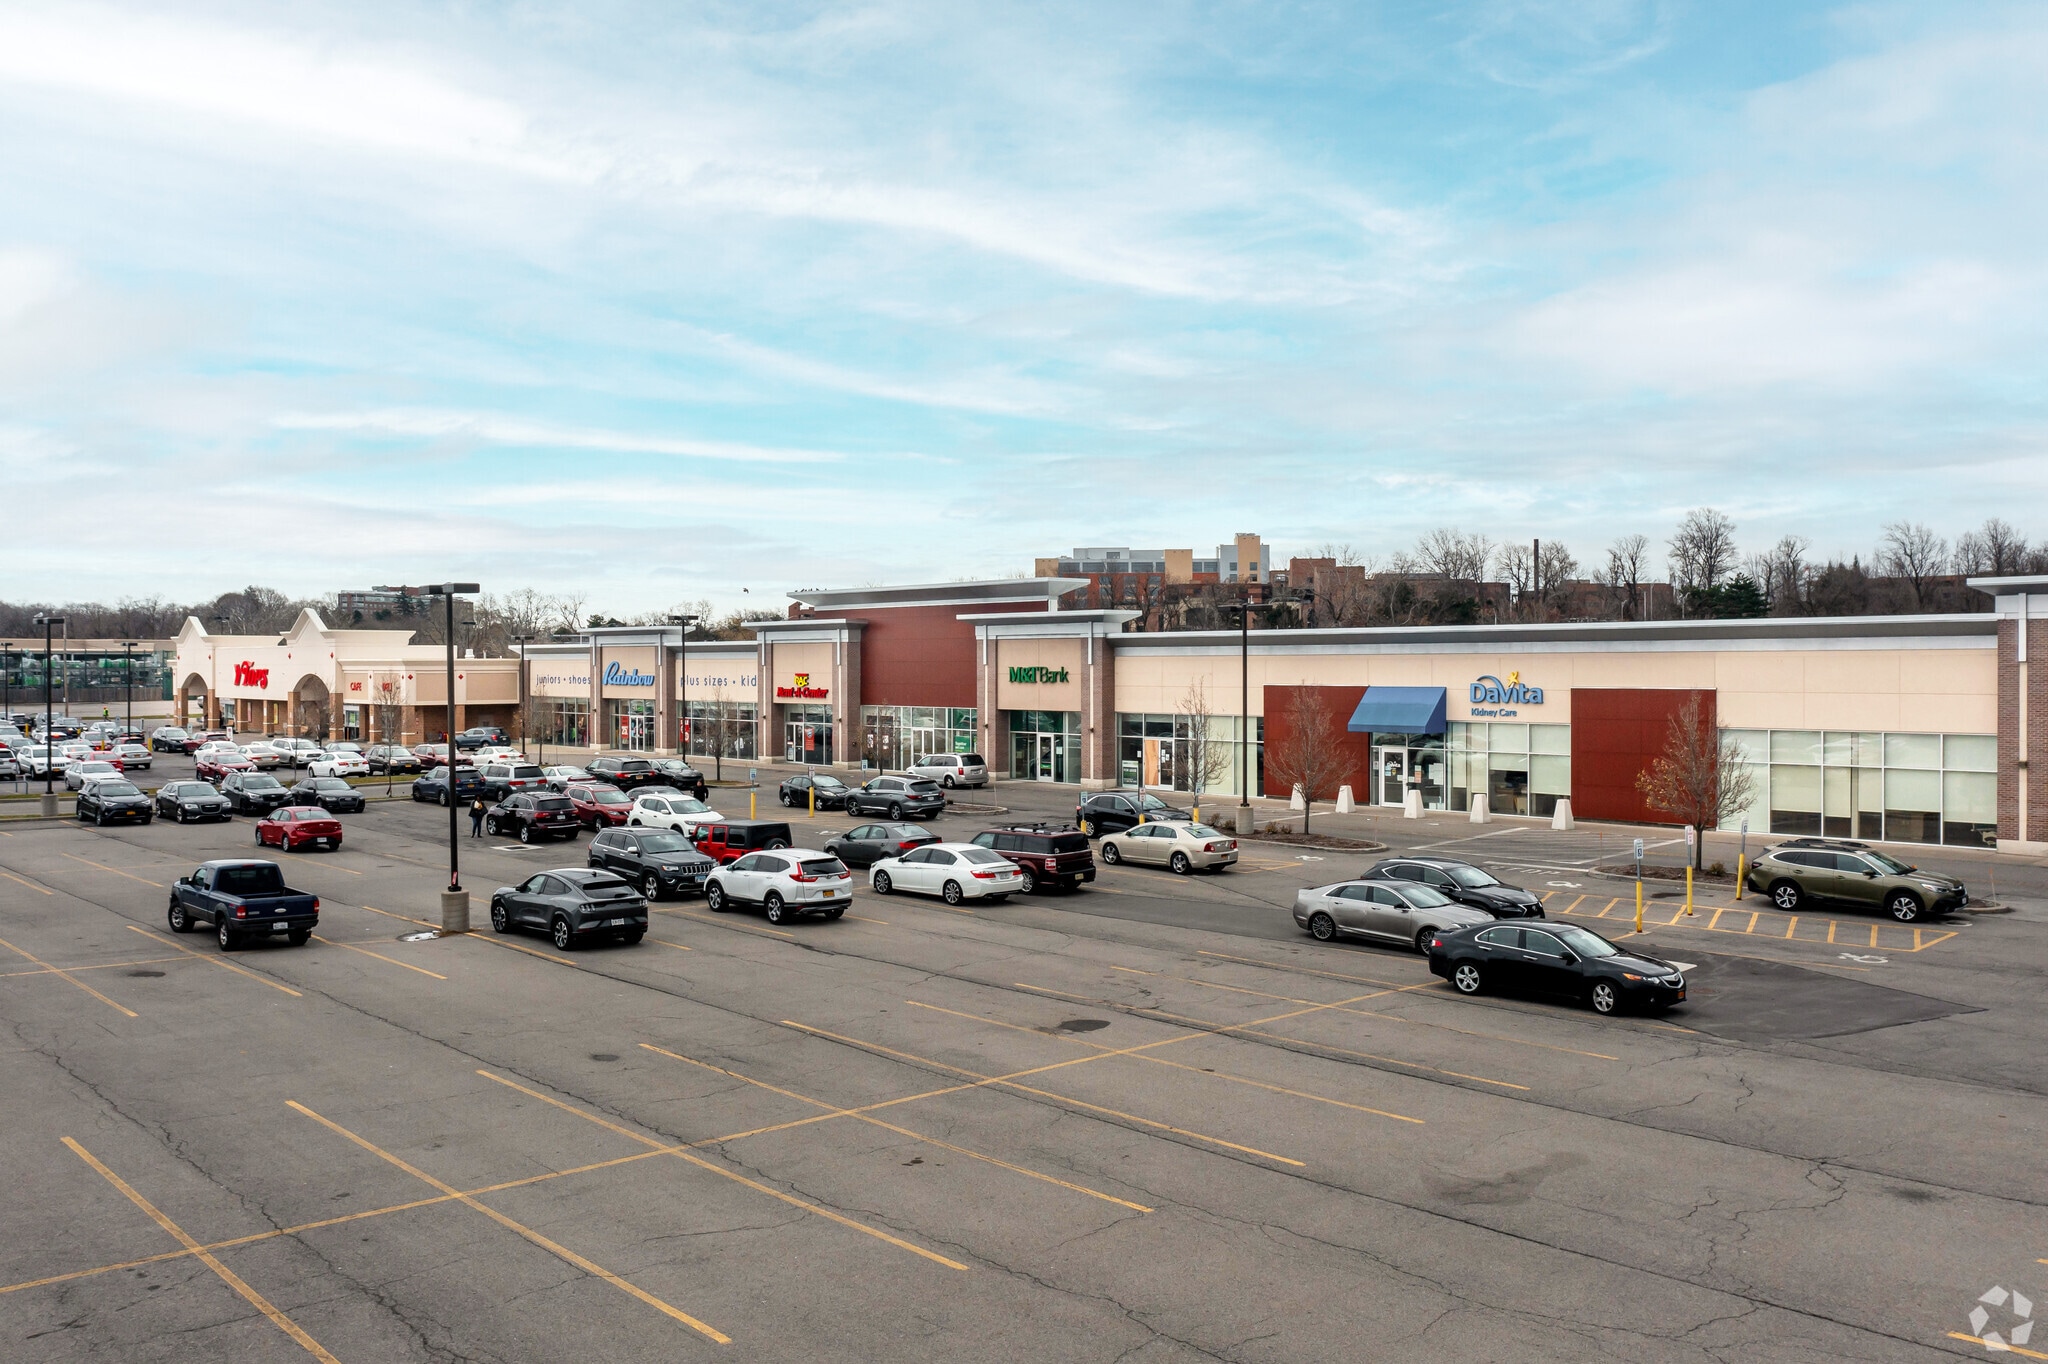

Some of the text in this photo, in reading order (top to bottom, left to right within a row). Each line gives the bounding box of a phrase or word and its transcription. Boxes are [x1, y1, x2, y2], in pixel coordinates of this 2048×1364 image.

[536, 674, 592, 686] juniors shoes
[602, 661, 654, 687] Rainbow
[680, 675, 699, 688] plus
[704, 674, 728, 687] sizes
[1008, 667, 1069, 684] M&T Bank
[1470, 676, 1544, 704] DaVita
[1471, 708, 1517, 718] Kidney Care
